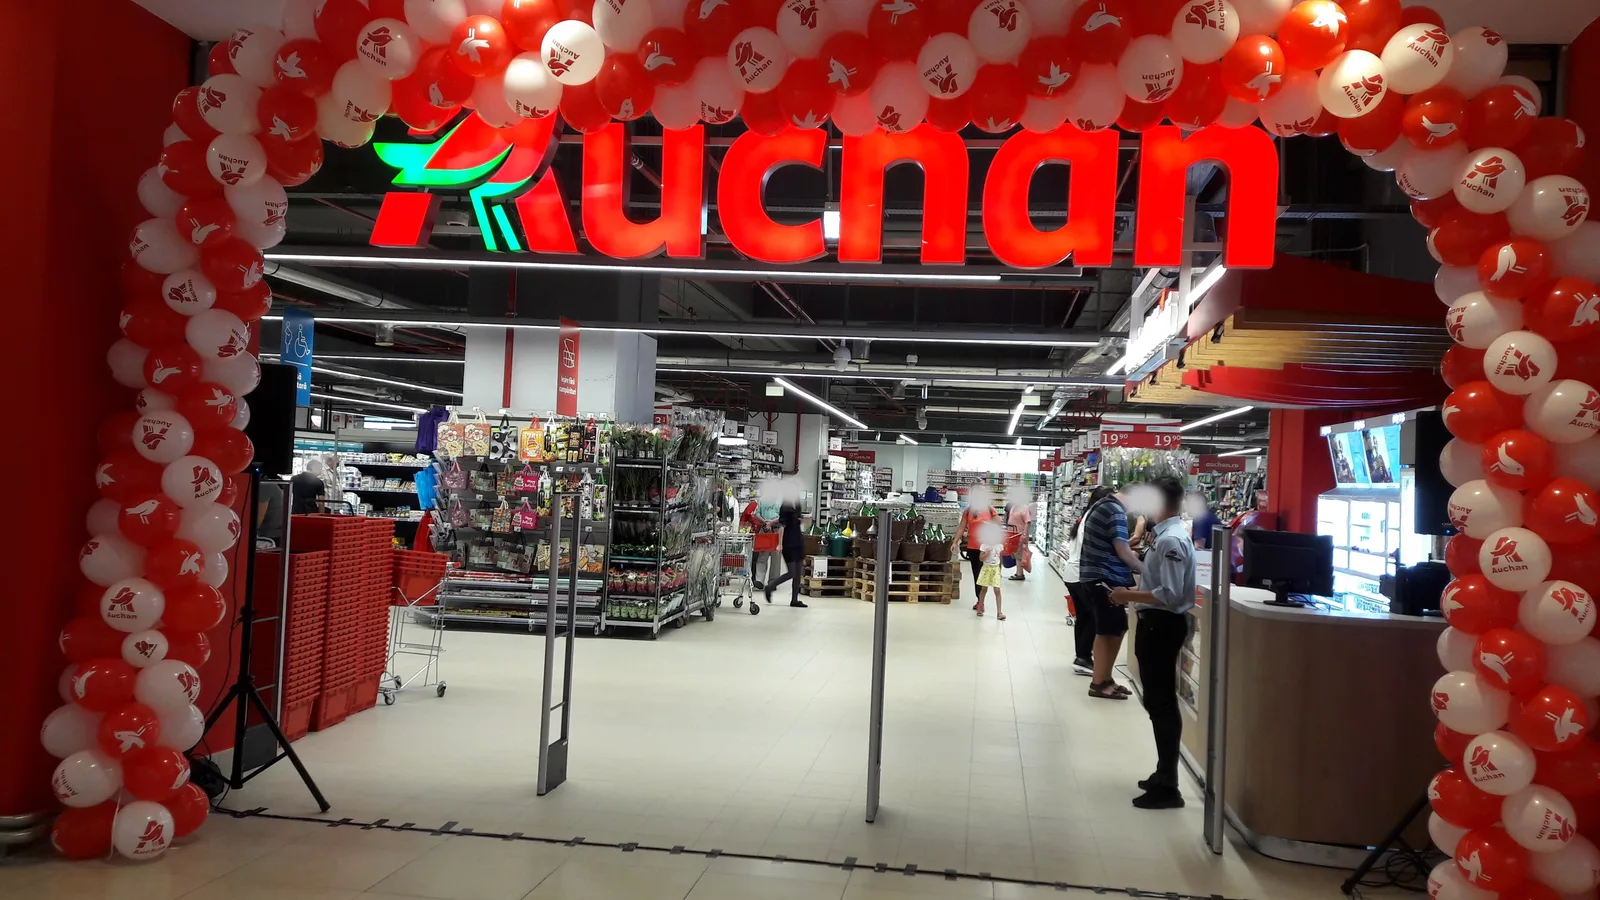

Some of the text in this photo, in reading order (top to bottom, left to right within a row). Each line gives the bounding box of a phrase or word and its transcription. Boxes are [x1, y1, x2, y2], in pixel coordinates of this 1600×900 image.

[359, 46, 387, 66] Auchan
[552, 38, 581, 60] Auchan
[1407, 41, 1439, 68] Auchan
[745, 59, 773, 84] Auchan
[923, 55, 950, 78] Auchan
[1142, 67, 1176, 80] Auchan
[1342, 84, 1363, 113] Auchan
[218, 153, 249, 166] Auchan
[370, 113, 1279, 269] Auchan
[1460, 178, 1495, 199] Auchan
[188, 279, 199, 303] Auchan
[1494, 343, 1515, 375] Auchan
[142, 418, 173, 428] Auchan
[194, 484, 220, 499] Auchan
[1492, 564, 1528, 574] Auchan
[107, 611, 138, 620] Auchan
[61, 768, 78, 796] Auchan
[1473, 772, 1505, 783] Auchan
[1536, 807, 1553, 840] Auchan
